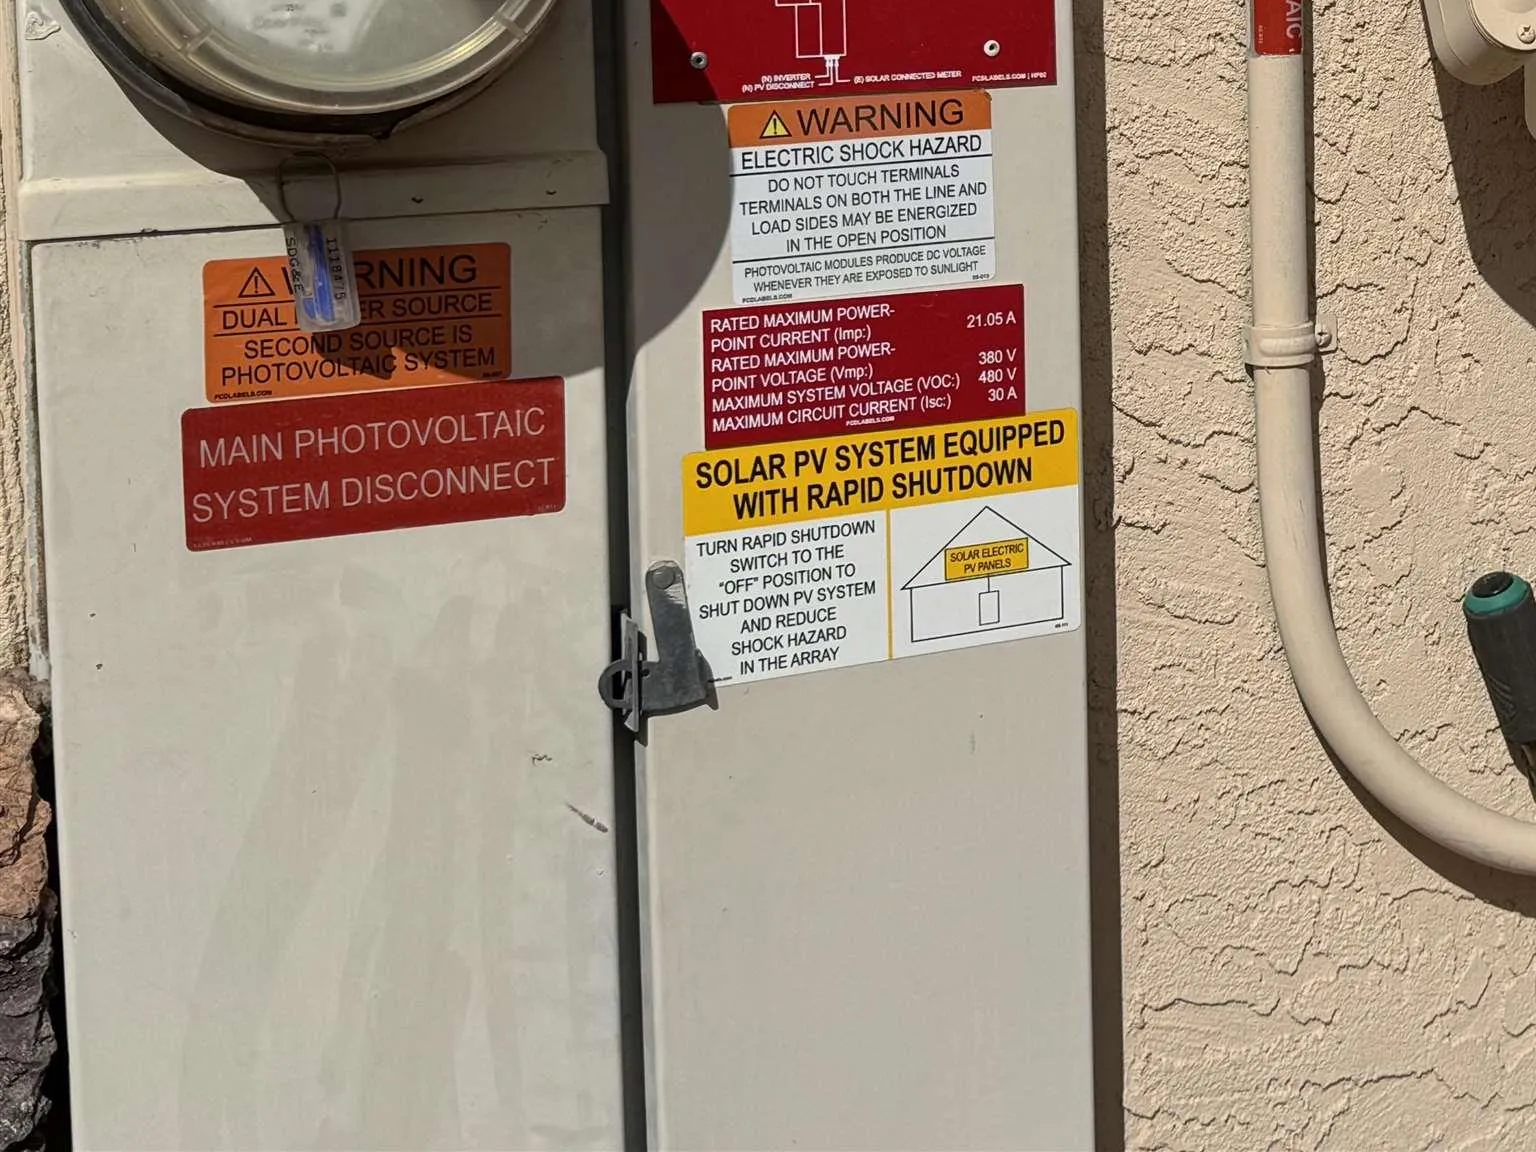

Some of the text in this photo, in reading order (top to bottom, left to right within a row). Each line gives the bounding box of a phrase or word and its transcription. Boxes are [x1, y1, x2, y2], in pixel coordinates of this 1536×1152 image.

[796, 98, 963, 136] WARNING
[741, 134, 982, 170] ELECTRIC SHOCK HAZARD
[767, 163, 960, 193] DO NOT TOUCH TERMINALS
[738, 181, 987, 216] TERMINALS ON BOTH THE LINE AND
[222, 306, 288, 330] DUAL
[396, 292, 492, 317] SOURCE
[710, 315, 760, 333] RATED
[763, 308, 833, 328] MAXIMUM
[966, 310, 1017, 328] 21.05 A
[243, 324, 472, 359] SECOND SOURCE IS
[711, 334, 757, 353] POINT
[759, 327, 831, 348] CURRENT
[222, 347, 494, 387] PHOTOVOLTAIC SYSTEM
[712, 391, 783, 412] MAXIMUM
[787, 384, 846, 404] SYSTEM
[848, 377, 913, 397] VOLTAGE
[987, 385, 1018, 402] 30 A
[712, 411, 783, 432] MAXIMUM
[787, 404, 846, 424] CIRCUIT
[848, 396, 917, 417] CURRENT
[199, 406, 545, 468] MAIN PHOTOVOLTAIC
[695, 419, 1065, 489] SOLAR PV SYSTEM EQUIPPED
[192, 457, 555, 522] SYSTEM DISCONNECT
[732, 456, 1032, 520] WITH RAPID SHUTDOWN
[696, 519, 875, 557] TURN RAPID SHUTDOWN
[949, 542, 1024, 563] SOLAR ELECTRIC
[963, 557, 1012, 574] PV PANELS
